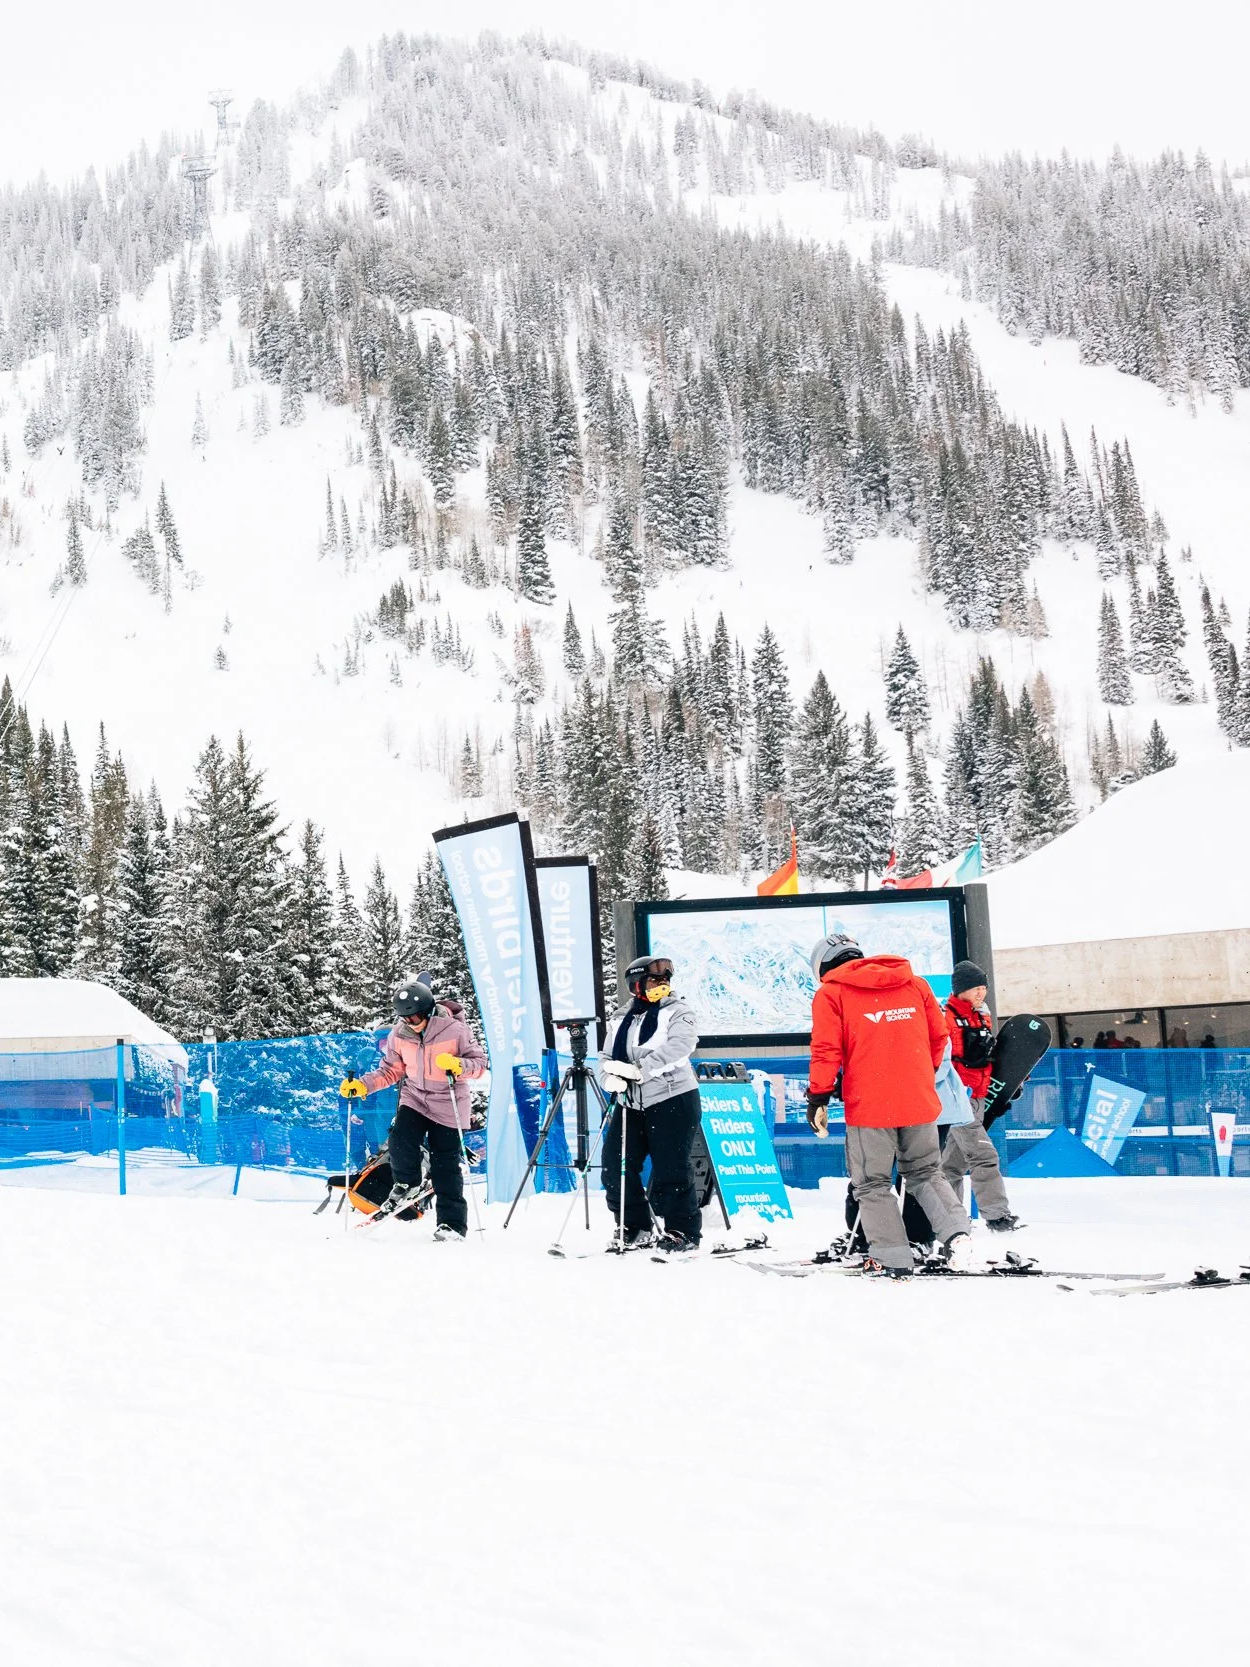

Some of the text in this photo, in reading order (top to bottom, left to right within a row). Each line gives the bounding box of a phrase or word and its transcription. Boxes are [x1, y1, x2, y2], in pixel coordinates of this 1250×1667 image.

[885, 1007, 916, 1016] MOUNTAIN
[886, 1013, 913, 1022] SCHOOL
[700, 1096, 753, 1112] Skiers &
[1112, 1097, 1133, 1129] school
[710, 1118, 754, 1134] Riders
[721, 1140, 756, 1156] ONLY
[718, 1164, 777, 1175] Past This Point
[735, 1192, 771, 1203] mountain
